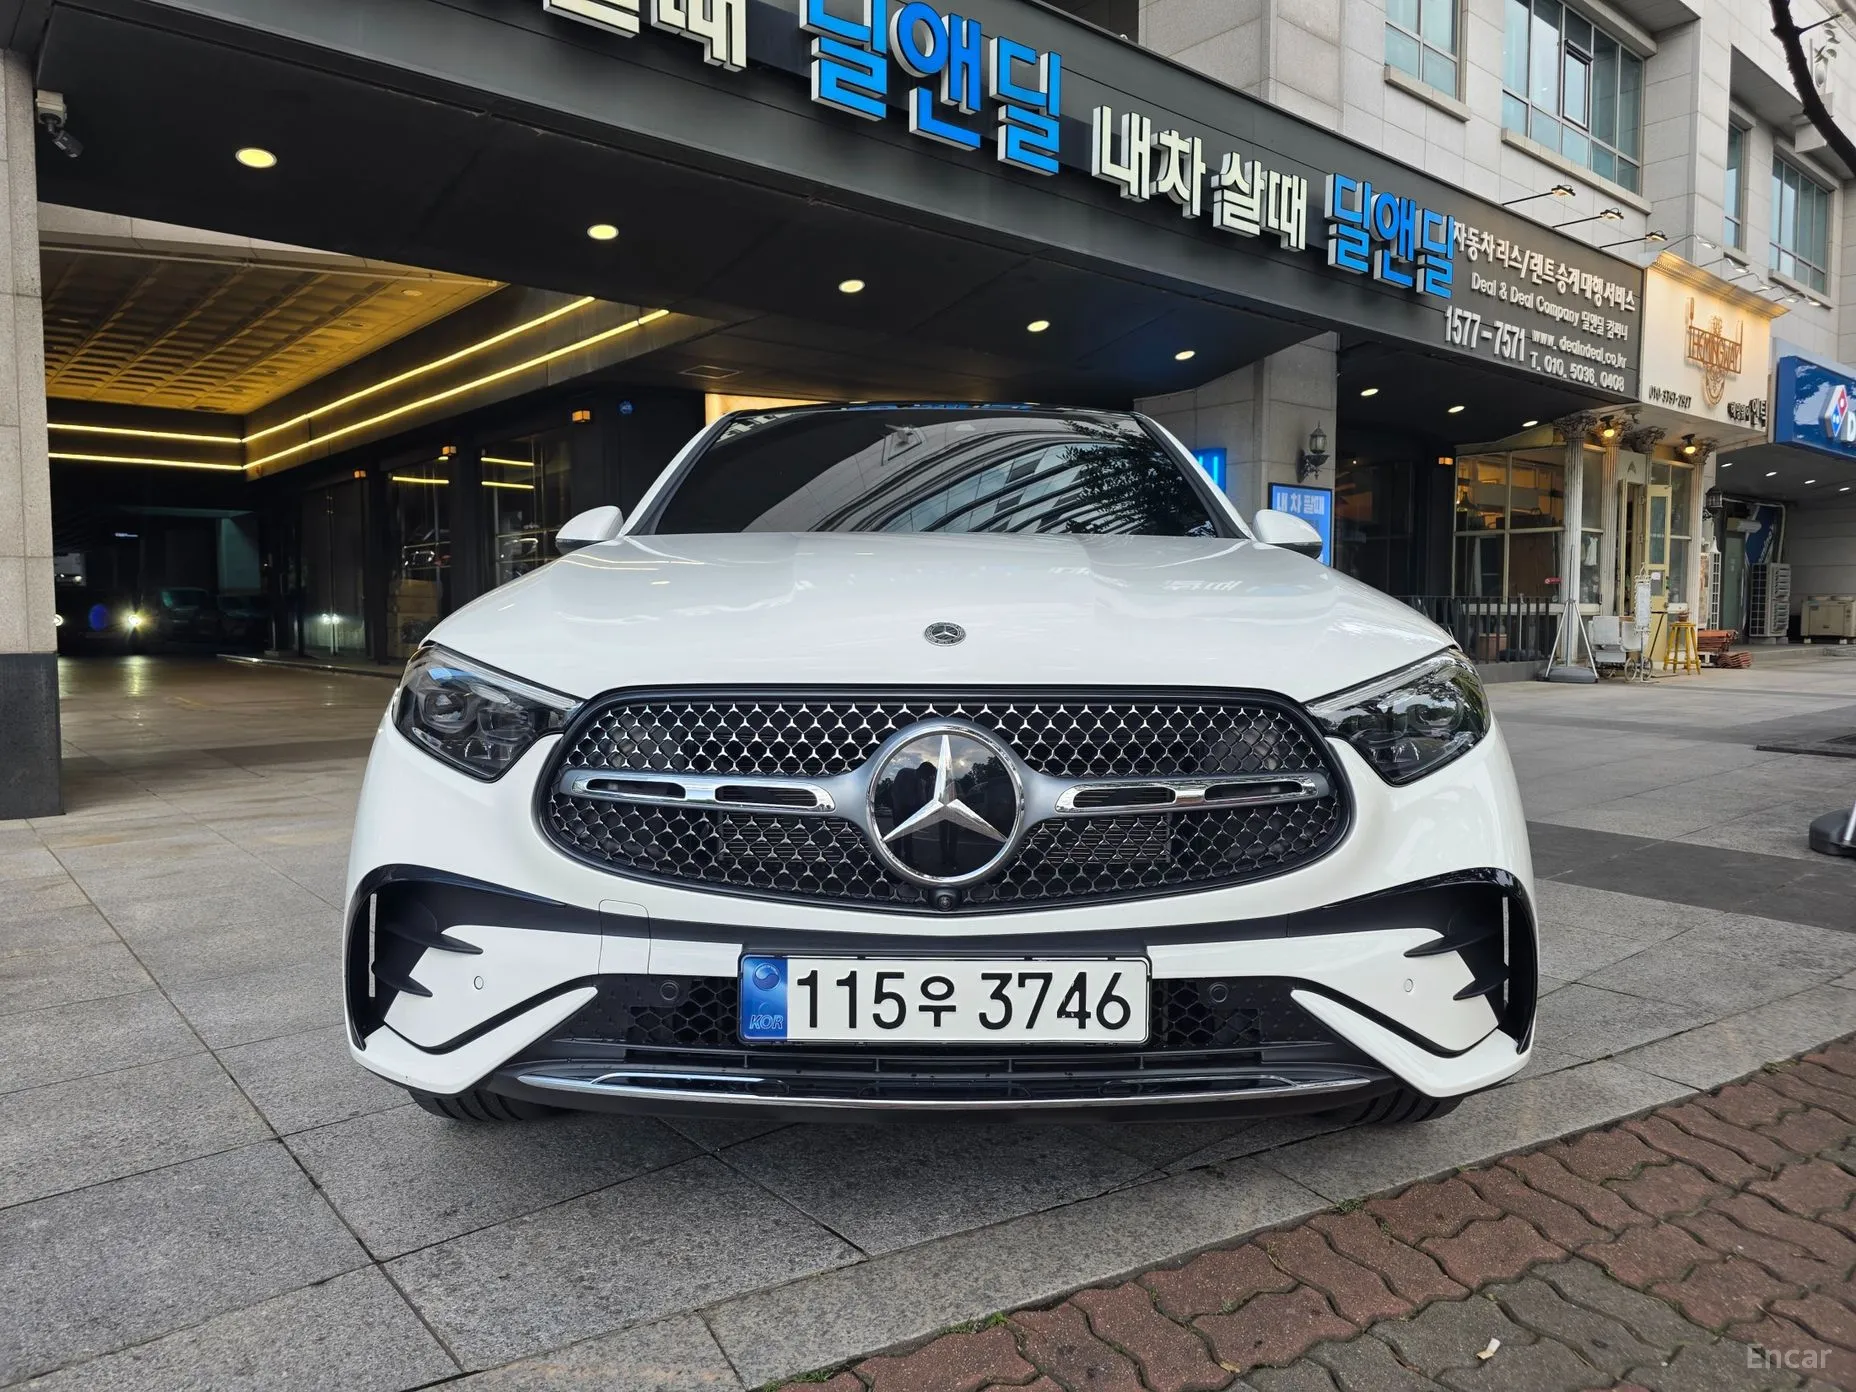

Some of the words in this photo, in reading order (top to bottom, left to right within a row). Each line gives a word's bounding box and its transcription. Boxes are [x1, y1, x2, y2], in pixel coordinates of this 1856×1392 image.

[800, 0, 1062, 175] 딜앤딜
[1092, 105, 1206, 219] 내차
[1211, 151, 1308, 252] 살때
[1325, 173, 1455, 299] 딜앤딜
[1445, 305, 1526, 363] 1577-7571
[1471, 272, 1497, 297] Deal
[1499, 282, 1508, 301] &
[1510, 286, 1534, 311] Deal
[1535, 295, 1580, 327] Company
[1581, 311, 1605, 336] 딜앤딜
[1605, 320, 1629, 341] 컴퍼니
[1600, 371, 1625, 393] 0408
[749, 1014, 784, 1030] KOR
[796, 969, 957, 1030] 115우
[978, 971, 1132, 1031] 3746
